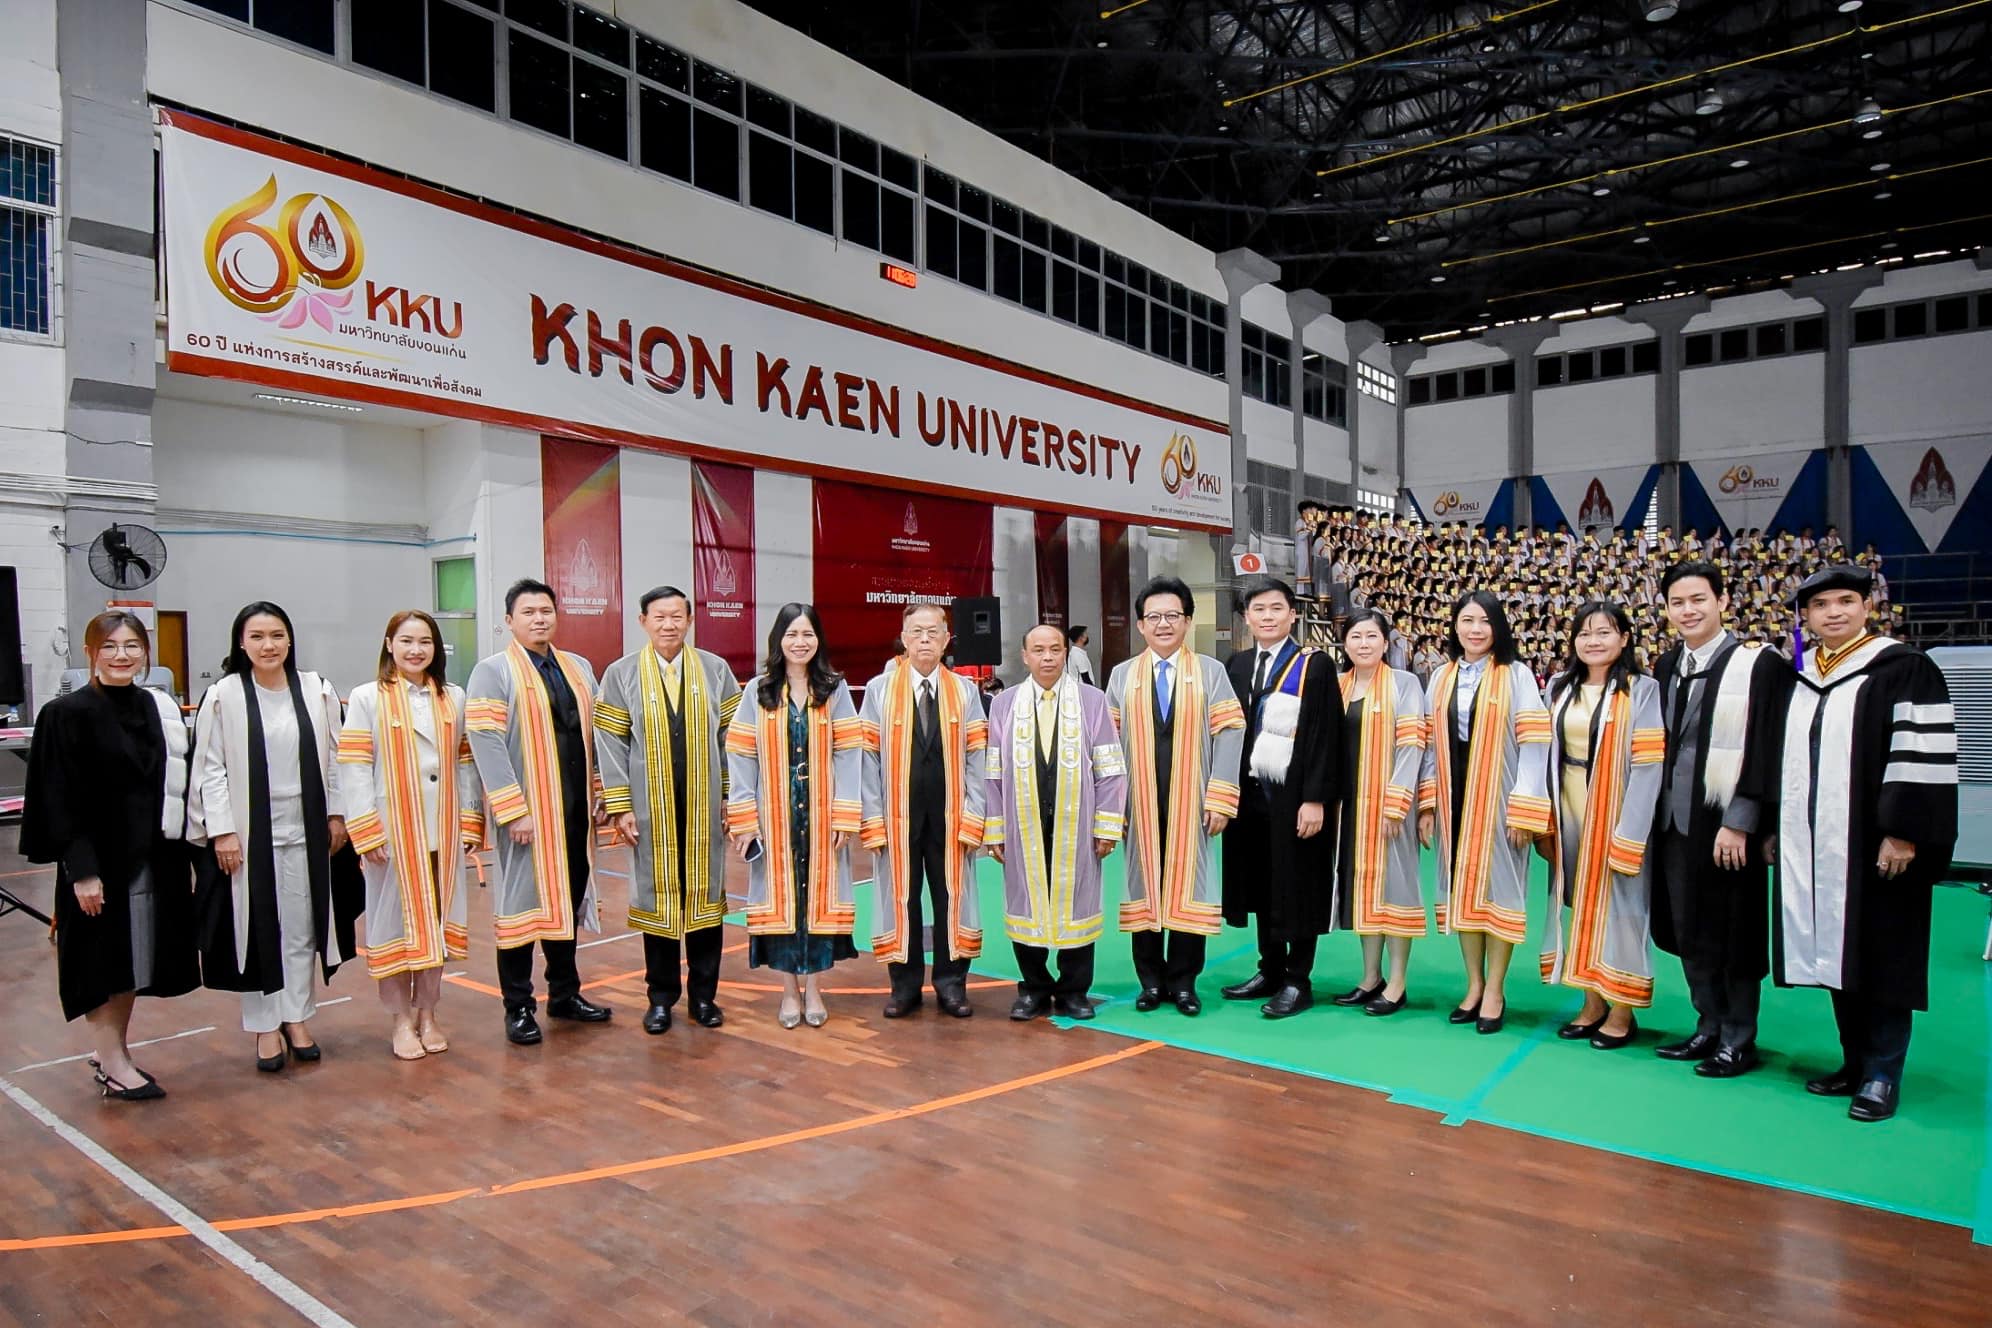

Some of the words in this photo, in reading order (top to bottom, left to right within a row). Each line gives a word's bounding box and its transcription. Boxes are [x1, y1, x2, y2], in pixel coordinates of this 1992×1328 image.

[366, 280, 463, 339] KKU
[187, 333, 211, 348] 60
[216, 335, 227, 350] ปี
[530, 293, 733, 405] KHON
[756, 350, 900, 438] KAEN
[917, 391, 1141, 484] UNIVERSITY
[1197, 472, 1221, 495] KKU
[1753, 477, 1780, 489] KKU
[1459, 502, 1480, 512] KKU
[1246, 558, 1254, 569] 1
